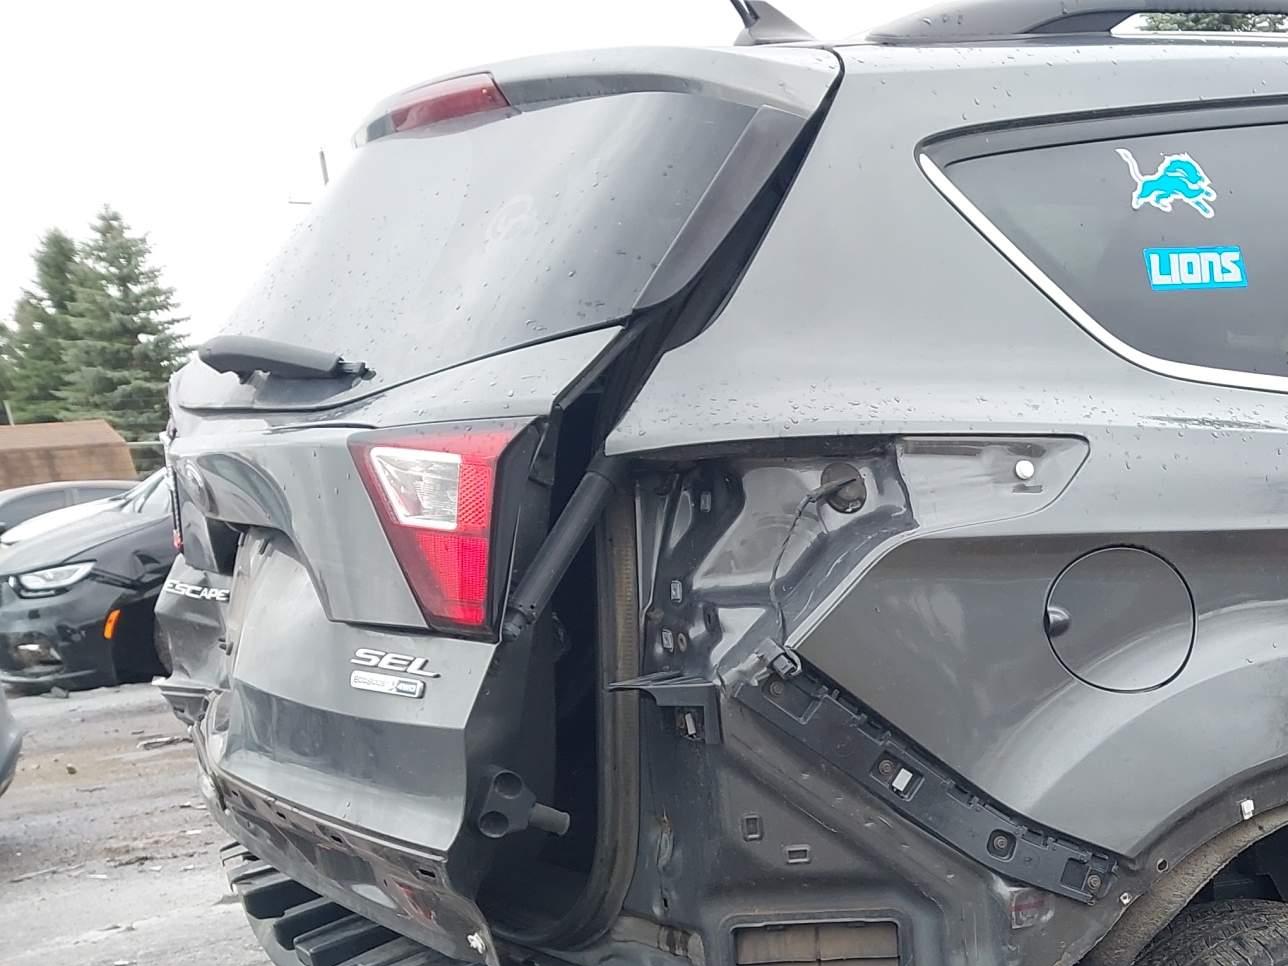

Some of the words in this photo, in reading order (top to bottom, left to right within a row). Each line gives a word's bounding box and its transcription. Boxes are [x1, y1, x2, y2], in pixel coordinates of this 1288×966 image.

[1149, 252, 1241, 285] LIONS
[165, 580, 229, 601] ESCAPE
[350, 648, 441, 678] SEL
